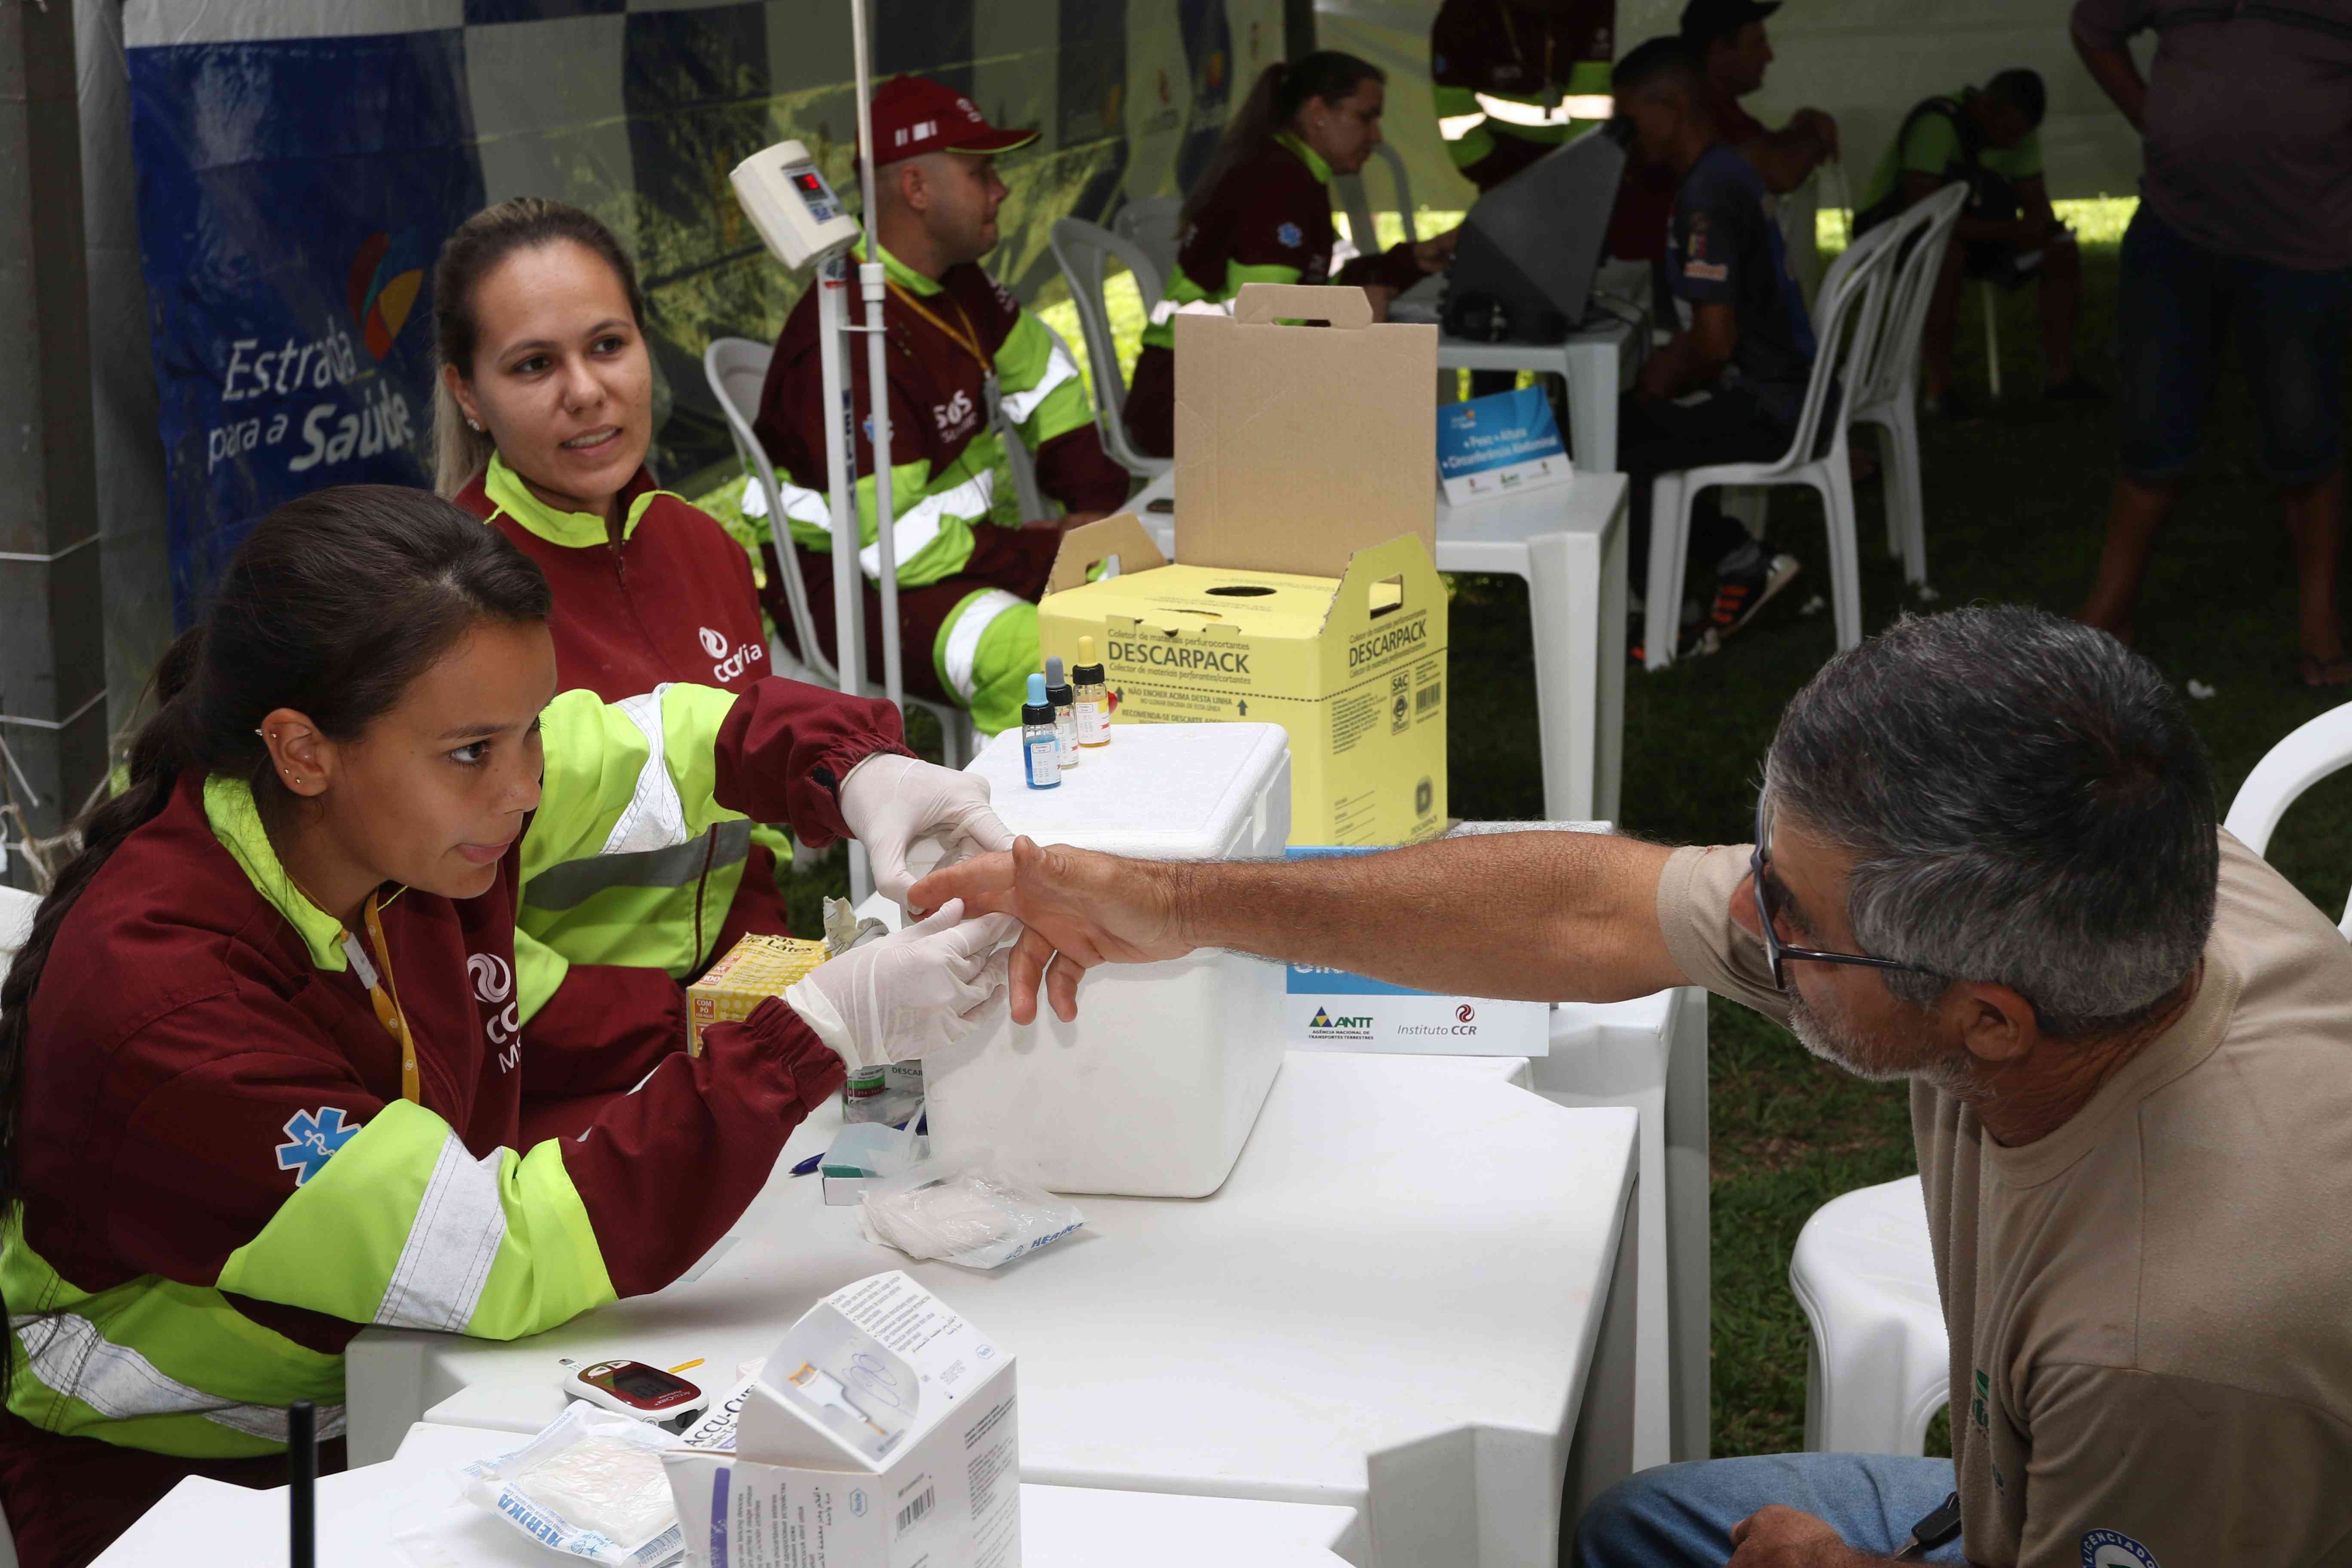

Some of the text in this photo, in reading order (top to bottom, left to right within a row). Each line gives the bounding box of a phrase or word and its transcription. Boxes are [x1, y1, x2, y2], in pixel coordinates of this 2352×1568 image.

[222, 315, 357, 401] Estrada
[208, 379, 415, 475] para a Saúde
[1108, 629, 1136, 640] Coletor
[1139, 632, 1148, 641] de
[1185, 638, 1250, 650] perfurocortantes
[1349, 619, 1427, 668] DESCARPACK
[1108, 641, 1250, 674] DESCARPACK
[1109, 662, 1136, 673] Colector
[1138, 664, 1146, 674] de
[1393, 674, 1408, 692] SAC
[1128, 687, 1232, 705] NÃO ENCHER ACIMA DESTA LINHA
[1122, 709, 1170, 721] RECOMENDA-SE
[1334, 1017, 1374, 1028] ANTT
[1397, 1025, 1477, 1035] Instituto CCR
[498, 1494, 565, 1547] HÉRIKA
[2084, 1532, 2156, 1568] LICENCIADO
